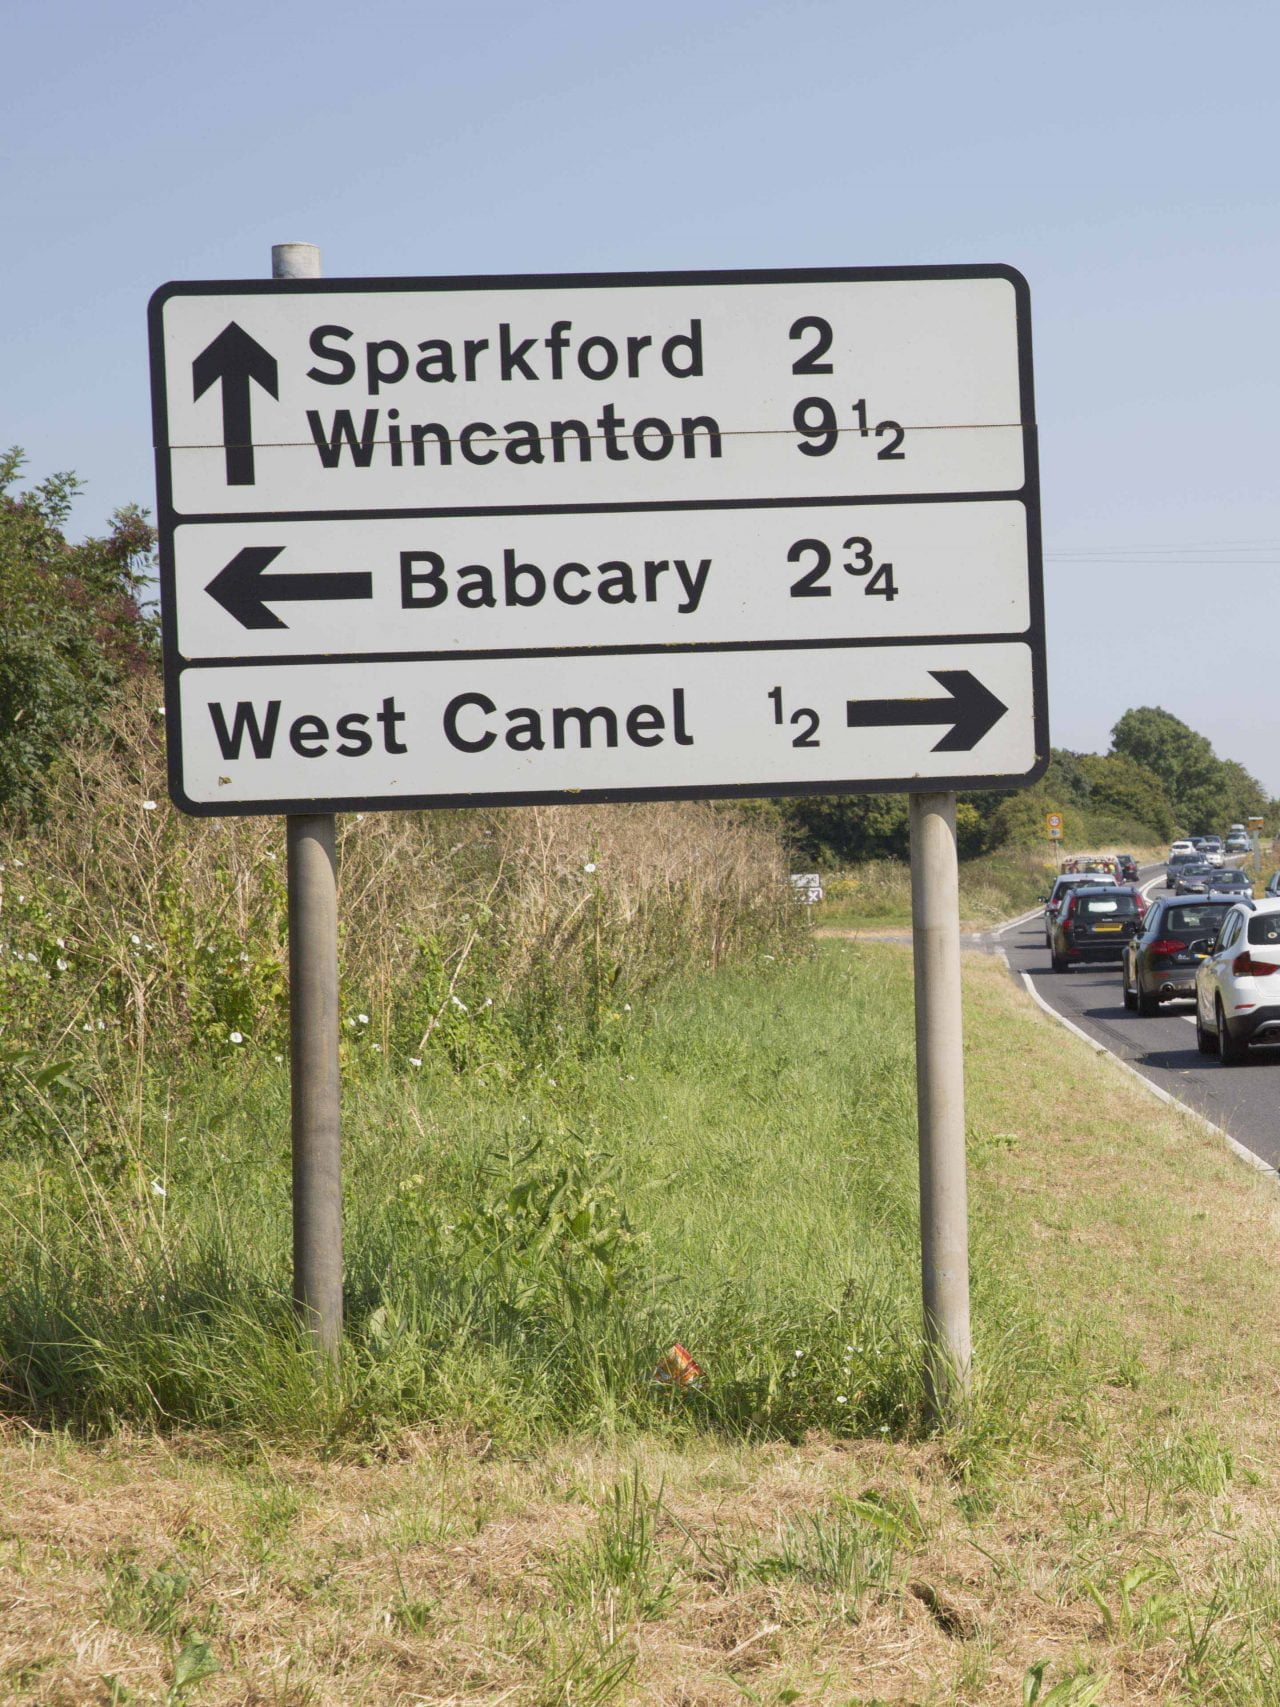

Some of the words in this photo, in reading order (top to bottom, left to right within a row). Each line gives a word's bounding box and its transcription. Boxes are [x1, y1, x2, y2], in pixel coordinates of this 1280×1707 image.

[306, 318, 703, 396] Sparkford
[789, 315, 834, 375] 2
[306, 403, 722, 469] Wincanton
[399, 548, 713, 614] Babcary
[207, 696, 408, 761] West
[443, 687, 694, 754] Camel
